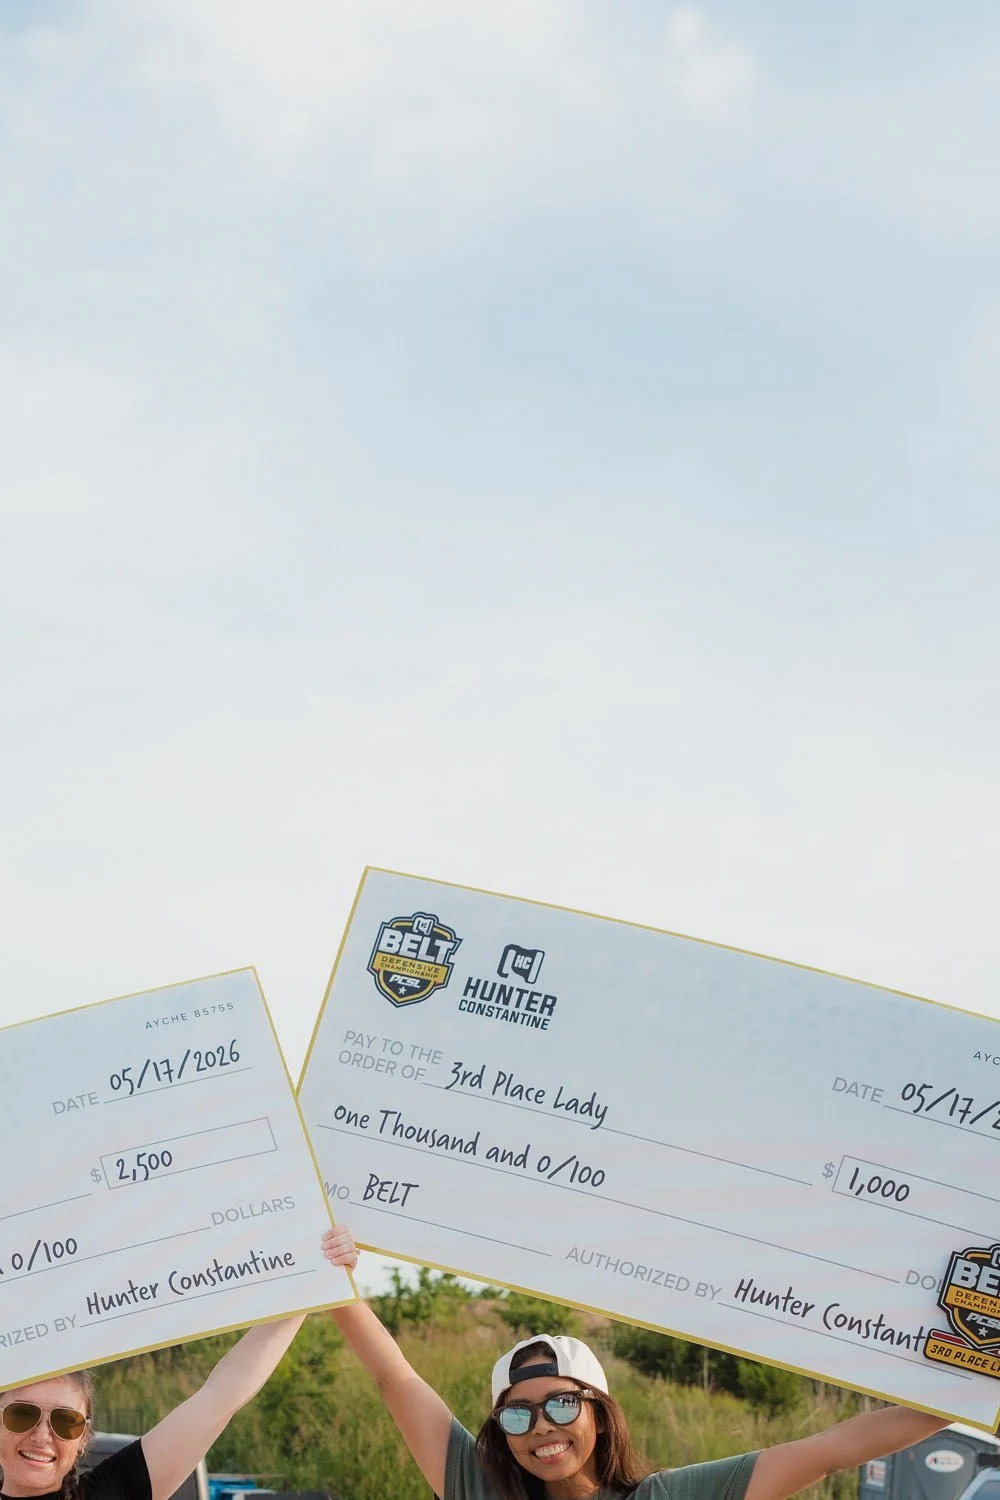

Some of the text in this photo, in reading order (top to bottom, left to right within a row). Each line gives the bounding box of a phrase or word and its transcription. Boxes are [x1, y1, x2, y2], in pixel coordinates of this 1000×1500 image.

[378, 928, 455, 965] BELT
[514, 955, 532, 969] HC
[380, 963, 438, 979] CHAMPIONSHIP
[381, 956, 440, 974] DEFENSIVE
[389, 974, 421, 988] PCSL
[463, 977, 557, 1016] HUNTER
[145, 1002, 235, 1030] AYCHE 85755
[458, 999, 550, 1031] CONSTANTINE
[344, 1031, 443, 1065] PAY TO THE
[973, 1051, 1000, 1065] AYC
[52, 1040, 240, 1115] DATE 05/17/2026
[339, 1051, 608, 1130] ORDER OF 3rd Place Lady
[833, 1077, 884, 1103] DATE
[334, 1105, 605, 1187] one Thousand and 0/100
[116, 1150, 172, 1181] 2,500
[363, 1173, 419, 1207] BELT
[849, 1168, 910, 1201] 1,000
[210, 1196, 296, 1227] DOLLARS
[11, 1238, 78, 1271] 0/100
[54, 1314, 77, 1333] BY
[86, 1280, 159, 1316] Hunter
[168, 1250, 295, 1296] Constantine
[951, 1258, 1000, 1296] BE
[566, 1247, 926, 1352] AUTHORIZED BY Hunter Constant
[955, 1298, 1000, 1315] CHAMPIO
[956, 1291, 1000, 1308] DEFEN
[930, 1344, 952, 1358] 3RD
[954, 1351, 989, 1369] PLACE
